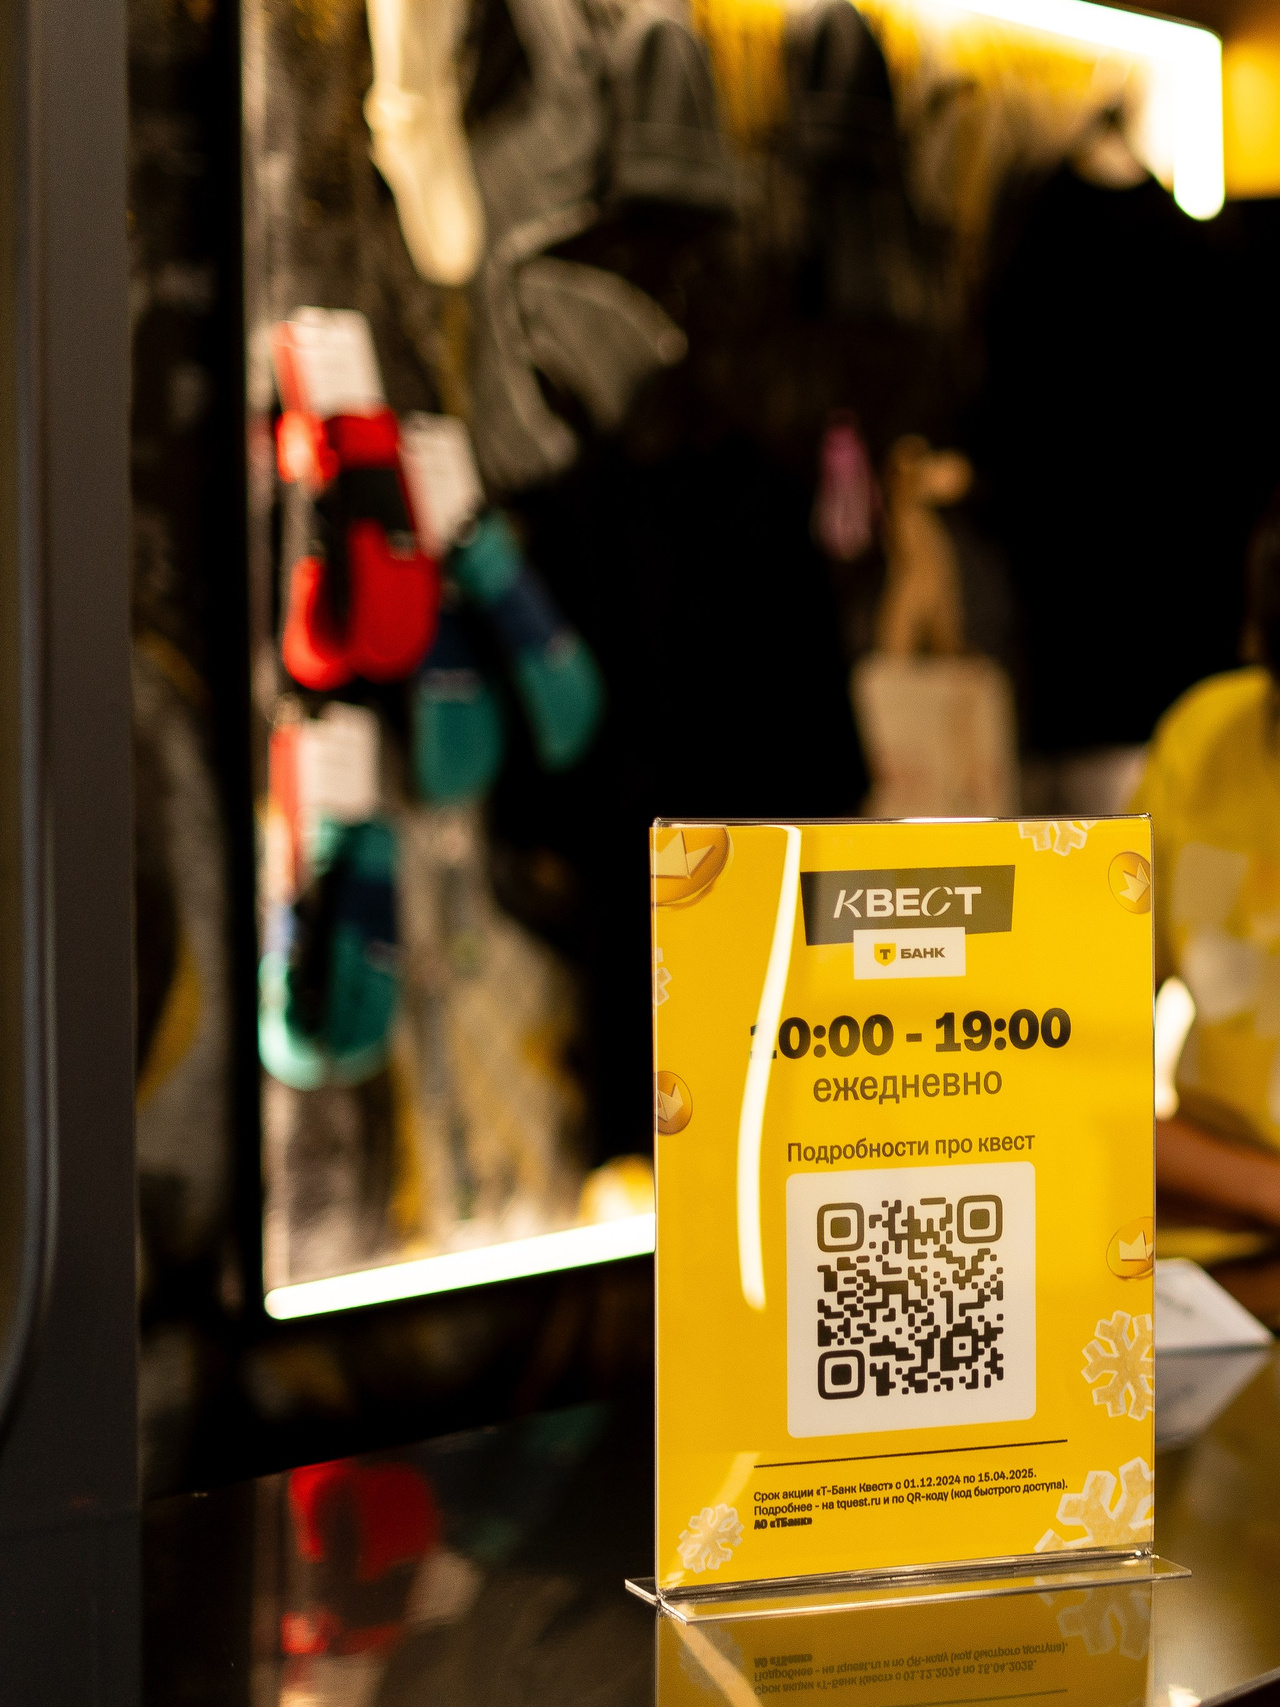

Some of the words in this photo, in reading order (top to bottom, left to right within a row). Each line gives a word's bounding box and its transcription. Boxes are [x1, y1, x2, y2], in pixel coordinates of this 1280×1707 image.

[833, 886, 982, 919] КВЕСТ
[900, 947, 946, 959] БАНК
[935, 1007, 1072, 1053] 19:00
[813, 1070, 1002, 1105] ежедневно
[787, 1137, 929, 1164] Подробности
[935, 1137, 972, 1158] про
[978, 1134, 1036, 1153] квест
[754, 1491, 780, 1503] Срок
[782, 1489, 814, 1500] акции
[816, 1485, 857, 1496] «Т-Банк
[859, 1482, 893, 1493] Квест»
[895, 1481, 901, 1490] с
[904, 1475, 961, 1489] 01.12.2024
[963, 1475, 976, 1484] по
[978, 1468, 1037, 1483] 15.04.2025.
[754, 1502, 813, 1516] Подробнее
[822, 1501, 834, 1510] на
[836, 1496, 881, 1511] tquest.ru
[883, 1496, 889, 1505] и
[892, 1494, 904, 1504] по
[906, 1490, 949, 1504] QR-коду
[951, 1488, 972, 1500] (код
[974, 1484, 1021, 1497] быстрого
[1023, 1479, 1068, 1494] доступа).
[754, 1519, 767, 1530] АО
